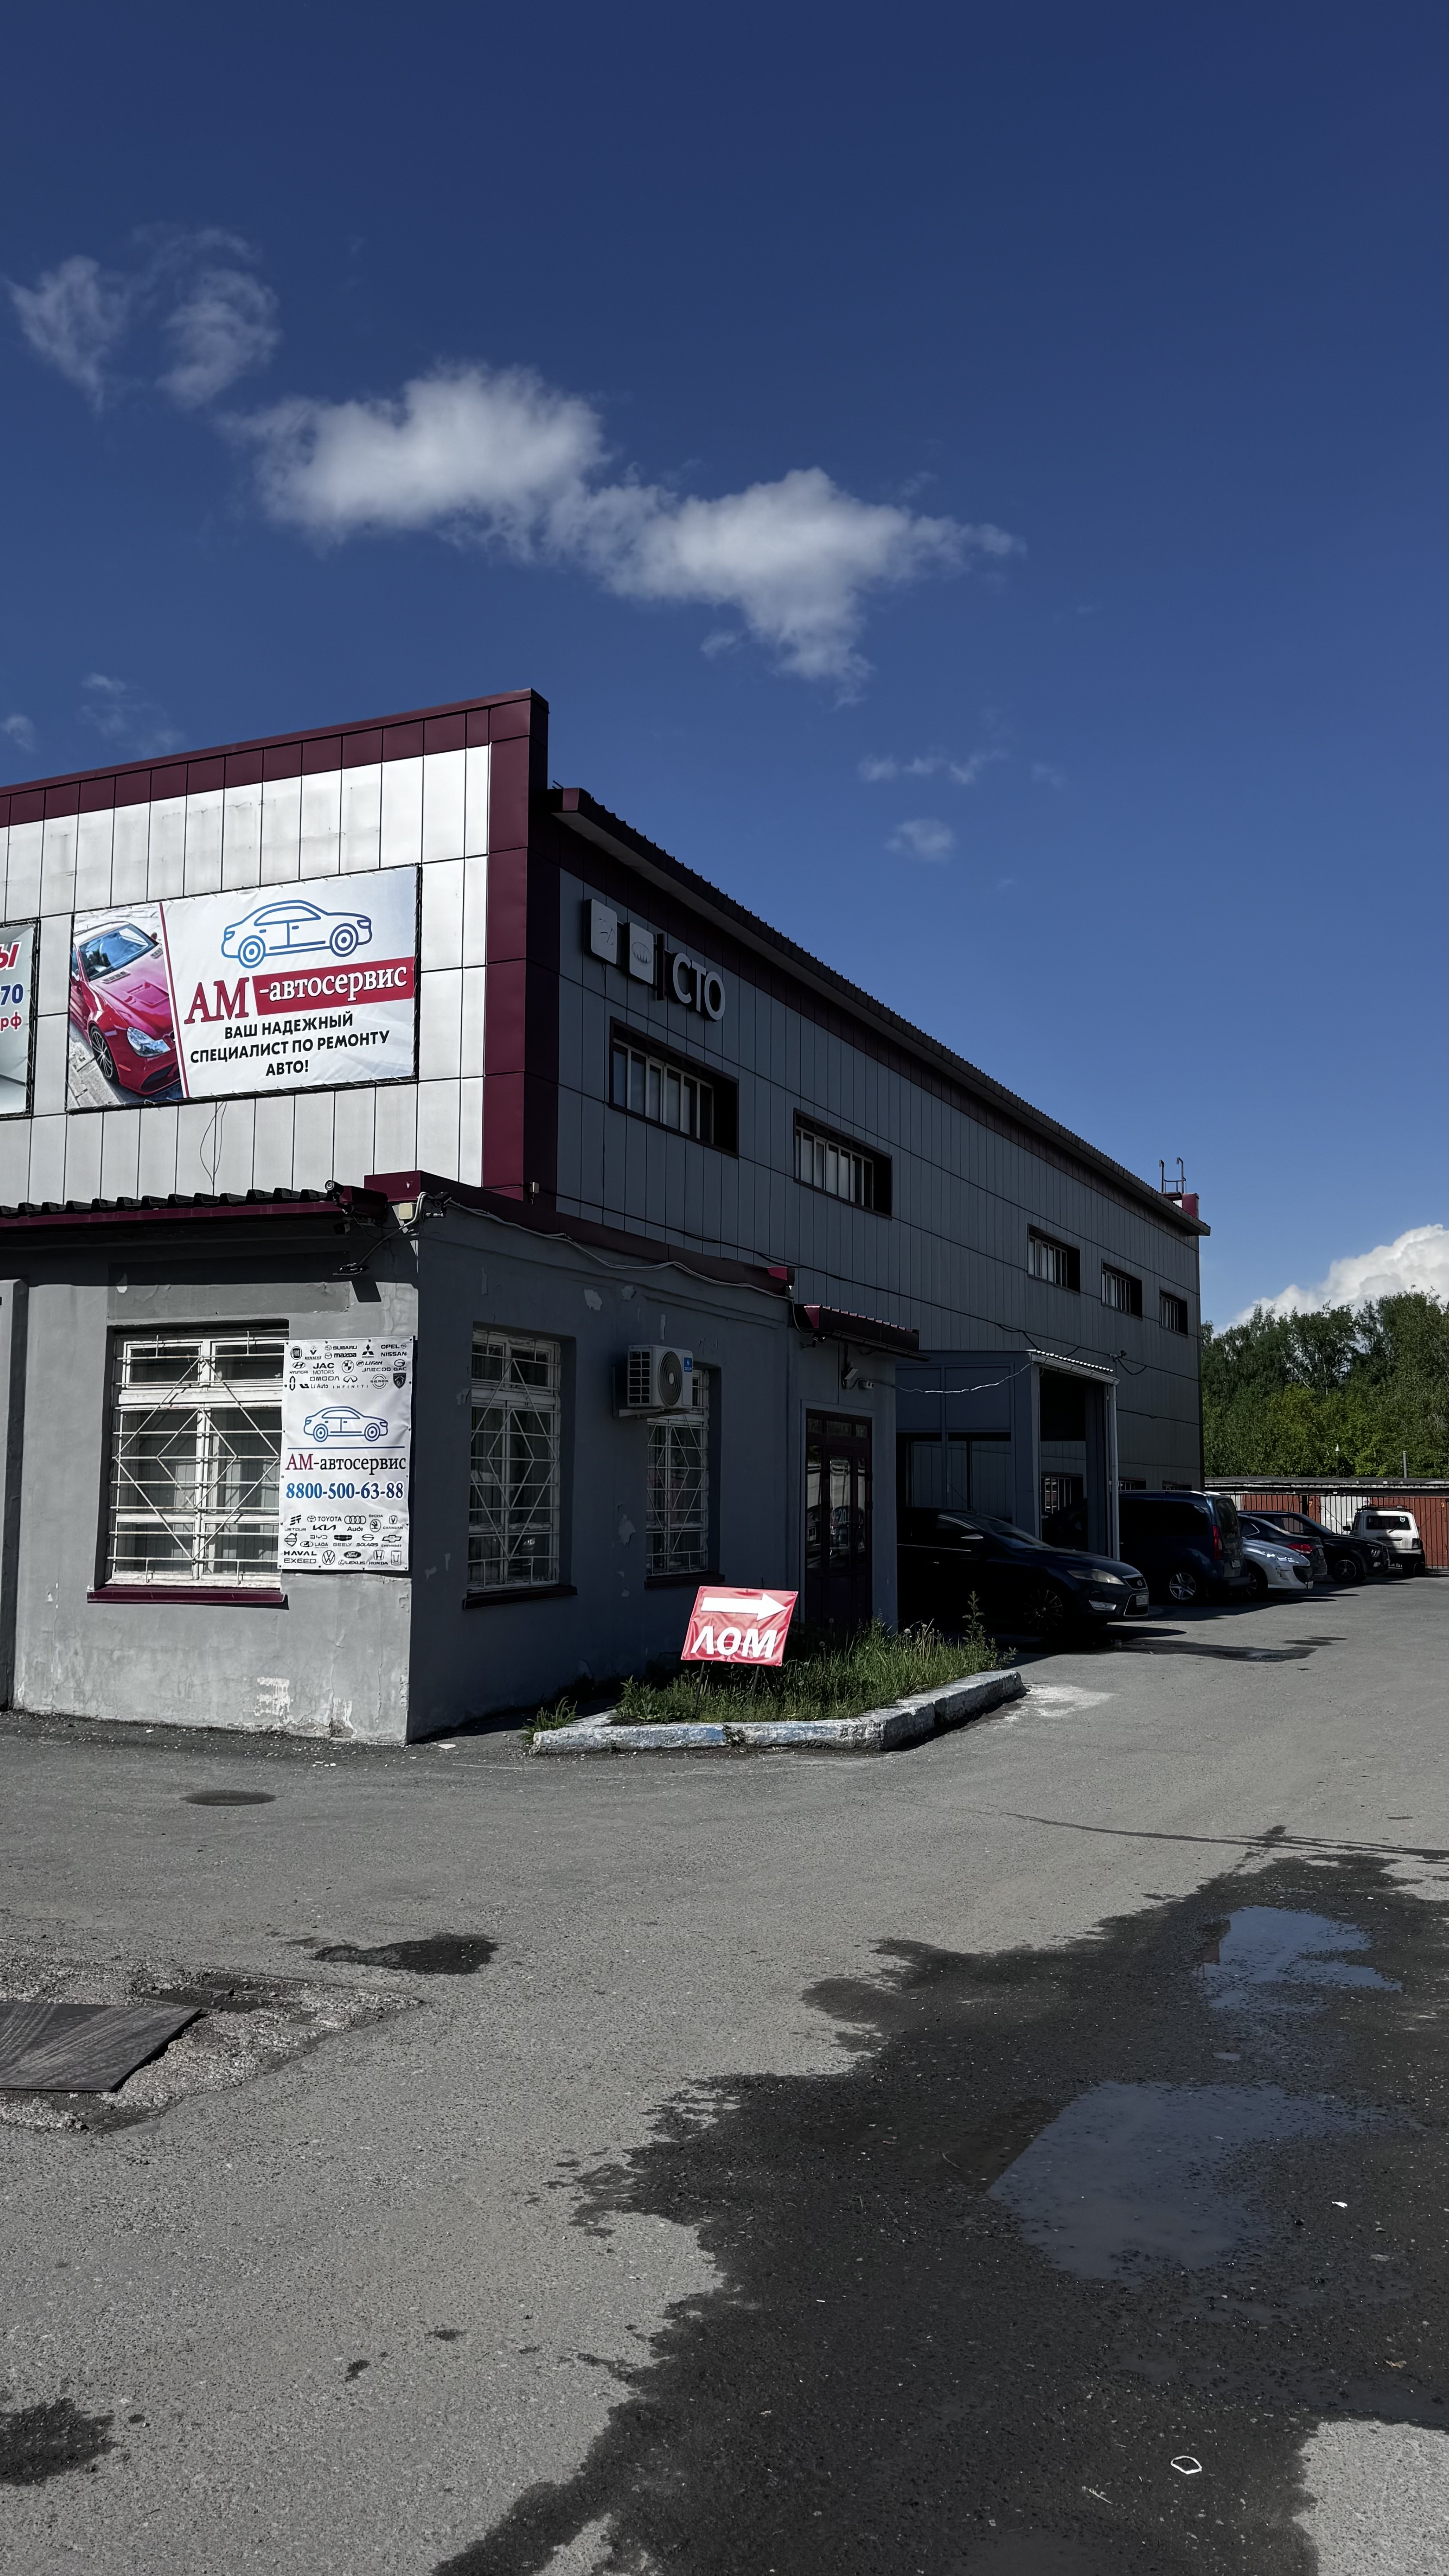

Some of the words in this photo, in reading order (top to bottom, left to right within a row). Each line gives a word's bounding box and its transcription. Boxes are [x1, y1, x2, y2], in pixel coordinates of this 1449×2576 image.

[184, 977, 249, 1024] АМ
[673, 952, 726, 1021] СТО
[225, 1024, 258, 1039] ВАШ
[262, 1011, 353, 1035] НАДЕЖНЫЙ
[190, 1041, 291, 1063] СПЕЦИАЛИСТ
[292, 1039, 313, 1053] ПО
[317, 1030, 390, 1050] РЕМОНТУ
[266, 1059, 308, 1076] АВТО!
[285, 1454, 406, 1475] АМ-автосервис
[286, 1481, 404, 1499] 8800-500-63-88
